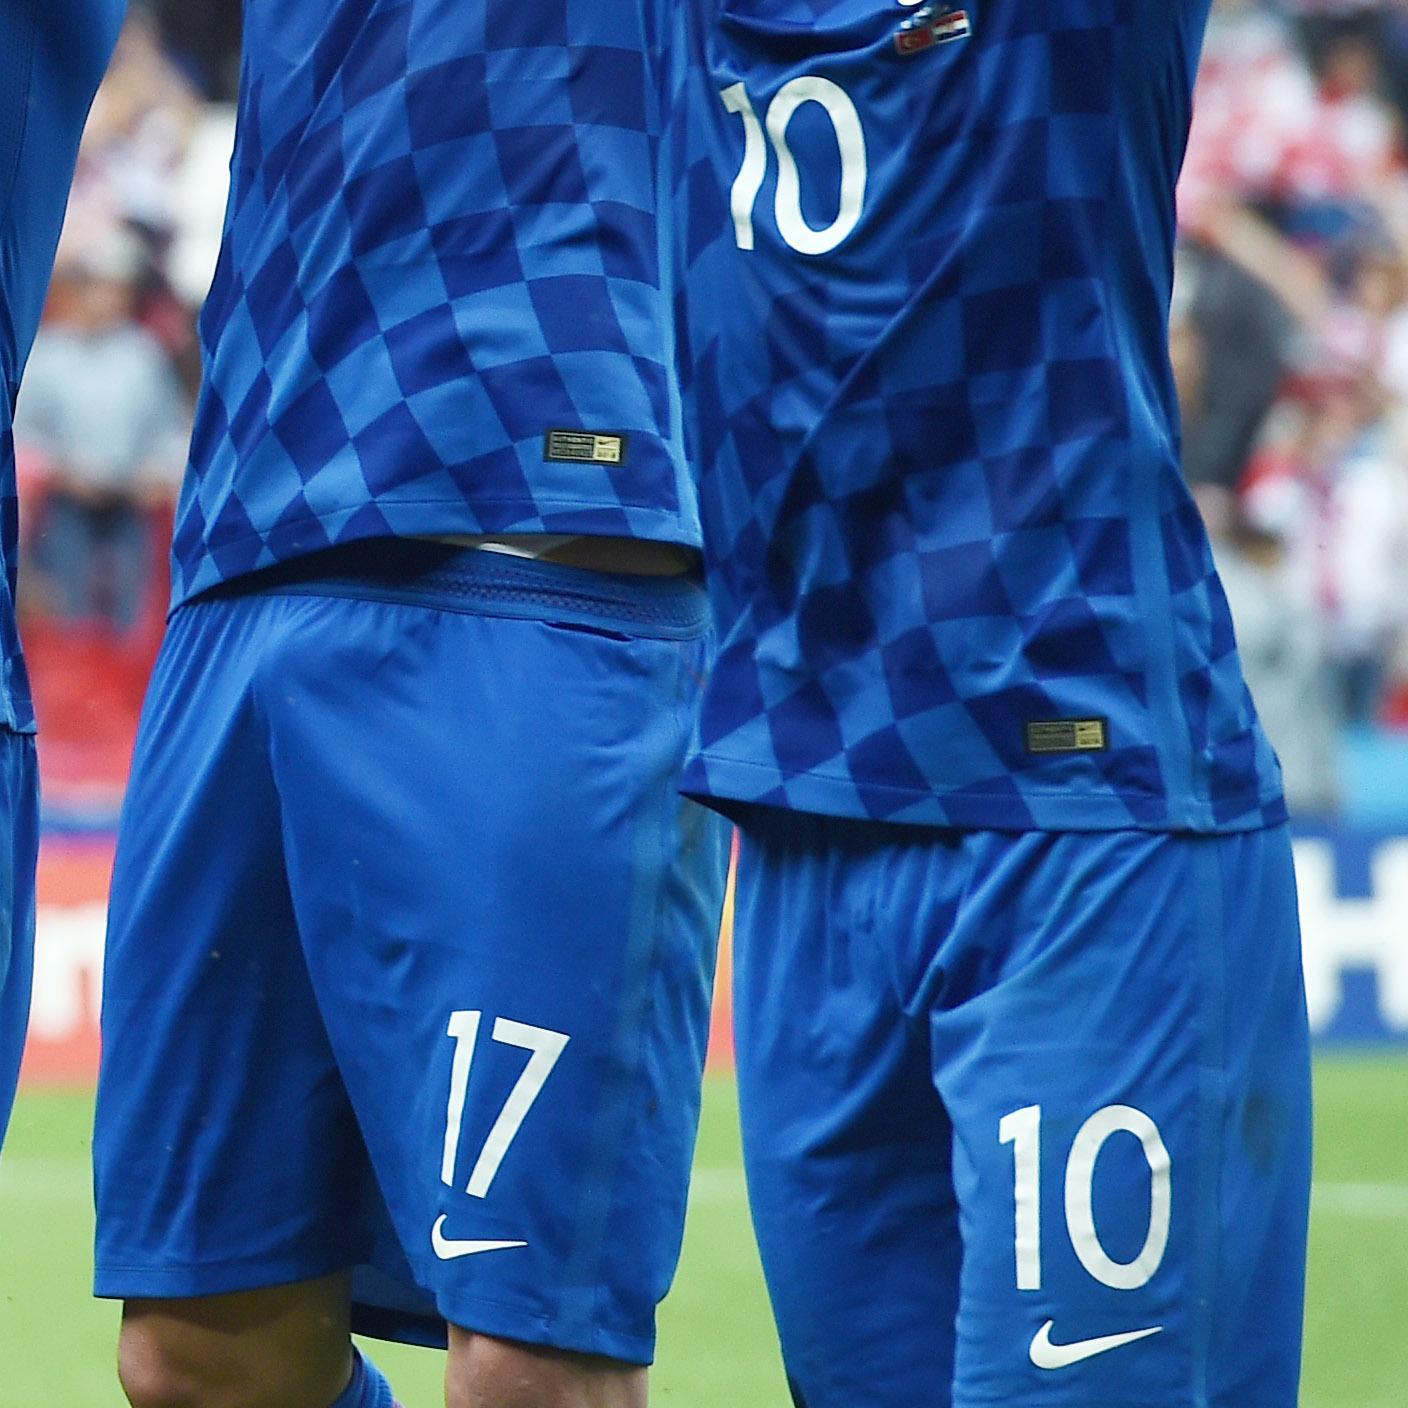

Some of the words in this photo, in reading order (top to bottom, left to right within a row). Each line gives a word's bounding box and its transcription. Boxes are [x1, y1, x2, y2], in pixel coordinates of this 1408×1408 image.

[719, 74, 868, 256] 10
[441, 1009, 571, 1200] 17
[998, 1103, 1173, 1291] 10
